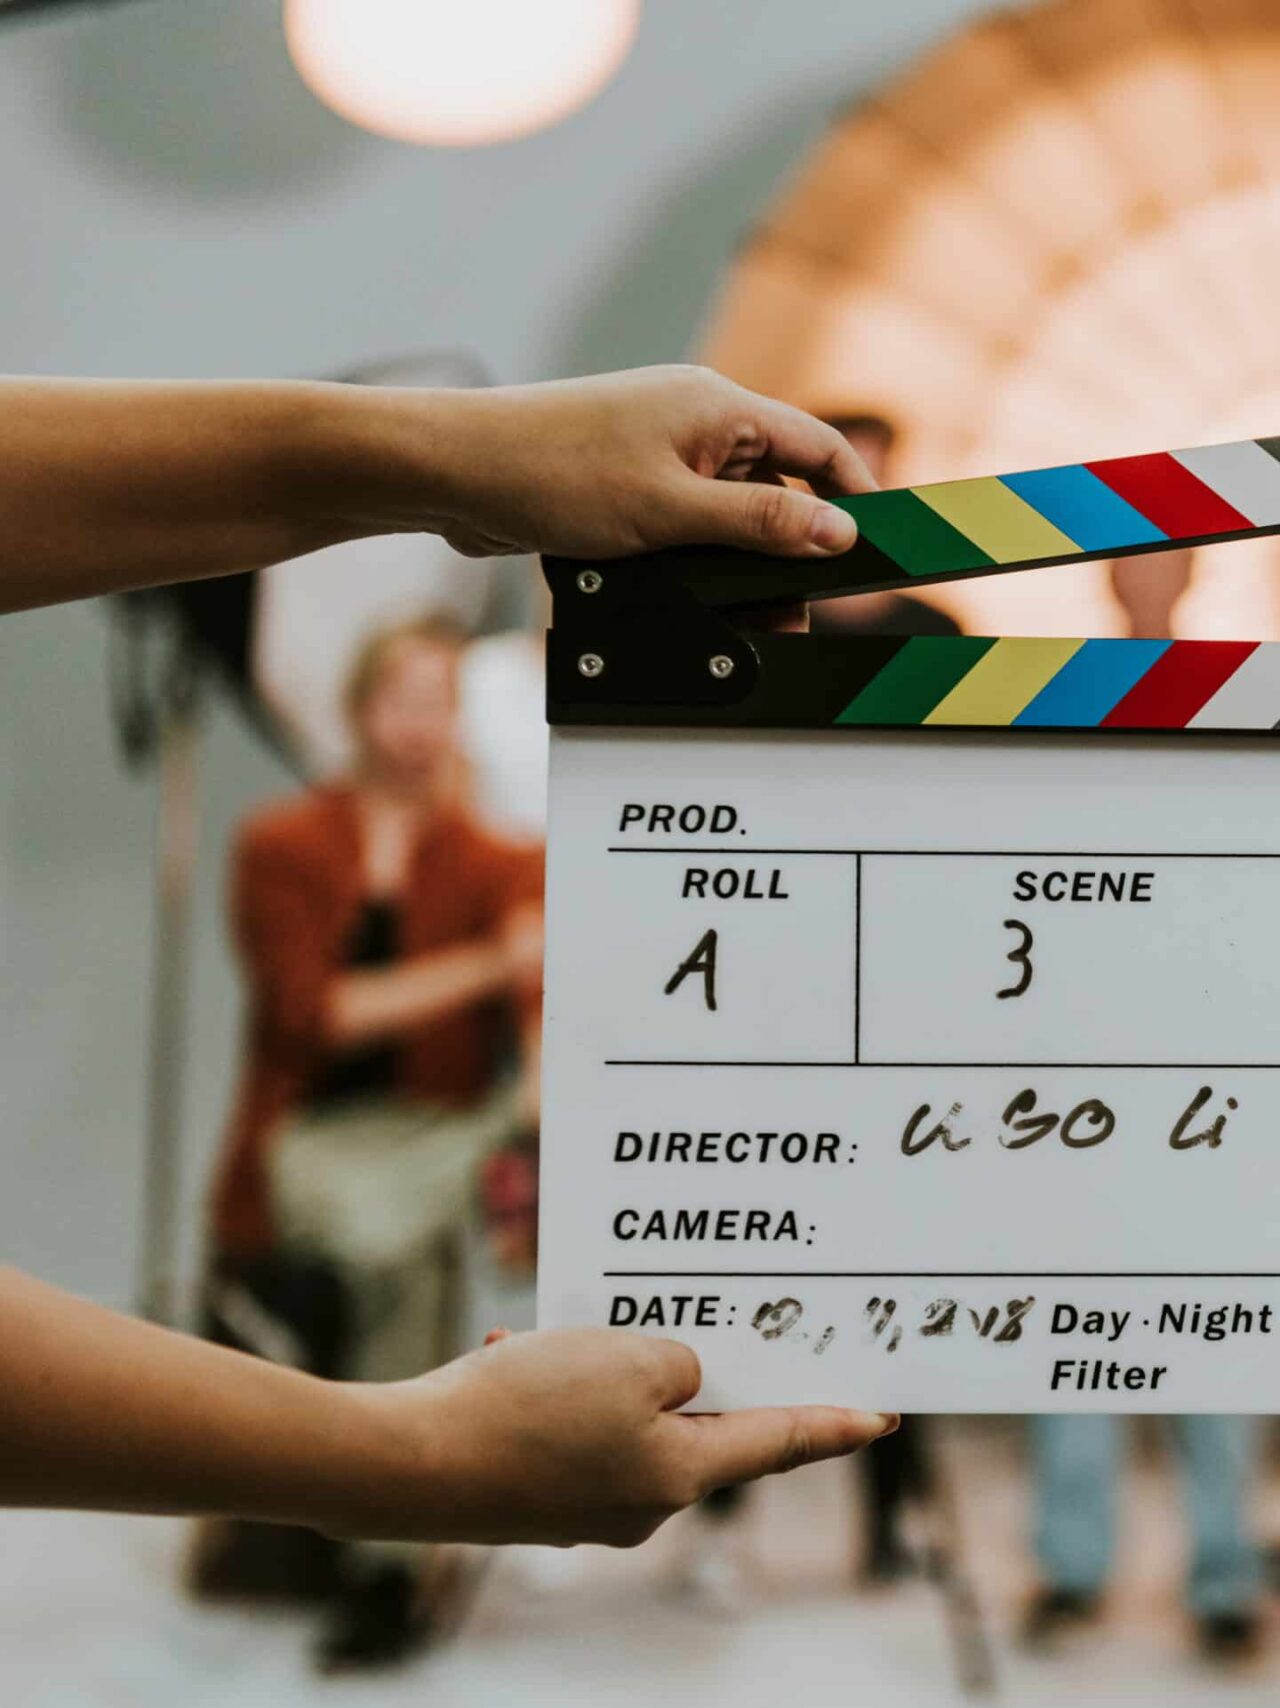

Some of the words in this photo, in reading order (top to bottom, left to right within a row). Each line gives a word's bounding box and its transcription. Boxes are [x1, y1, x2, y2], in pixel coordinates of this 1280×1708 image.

[617, 803, 748, 836] PROD.
[680, 867, 790, 901] ROLL
[1011, 869, 1156, 904] SCENE
[663, 927, 719, 1013] A
[995, 918, 1035, 1001] 3
[612, 1130, 859, 1165] DIRECTOR:
[611, 1208, 817, 1247] CAMERA:
[607, 1294, 738, 1328] DATE:
[1049, 1302, 1132, 1342] Day
[1157, 1302, 1274, 1342] Night
[1049, 1358, 1169, 1392] Filter
